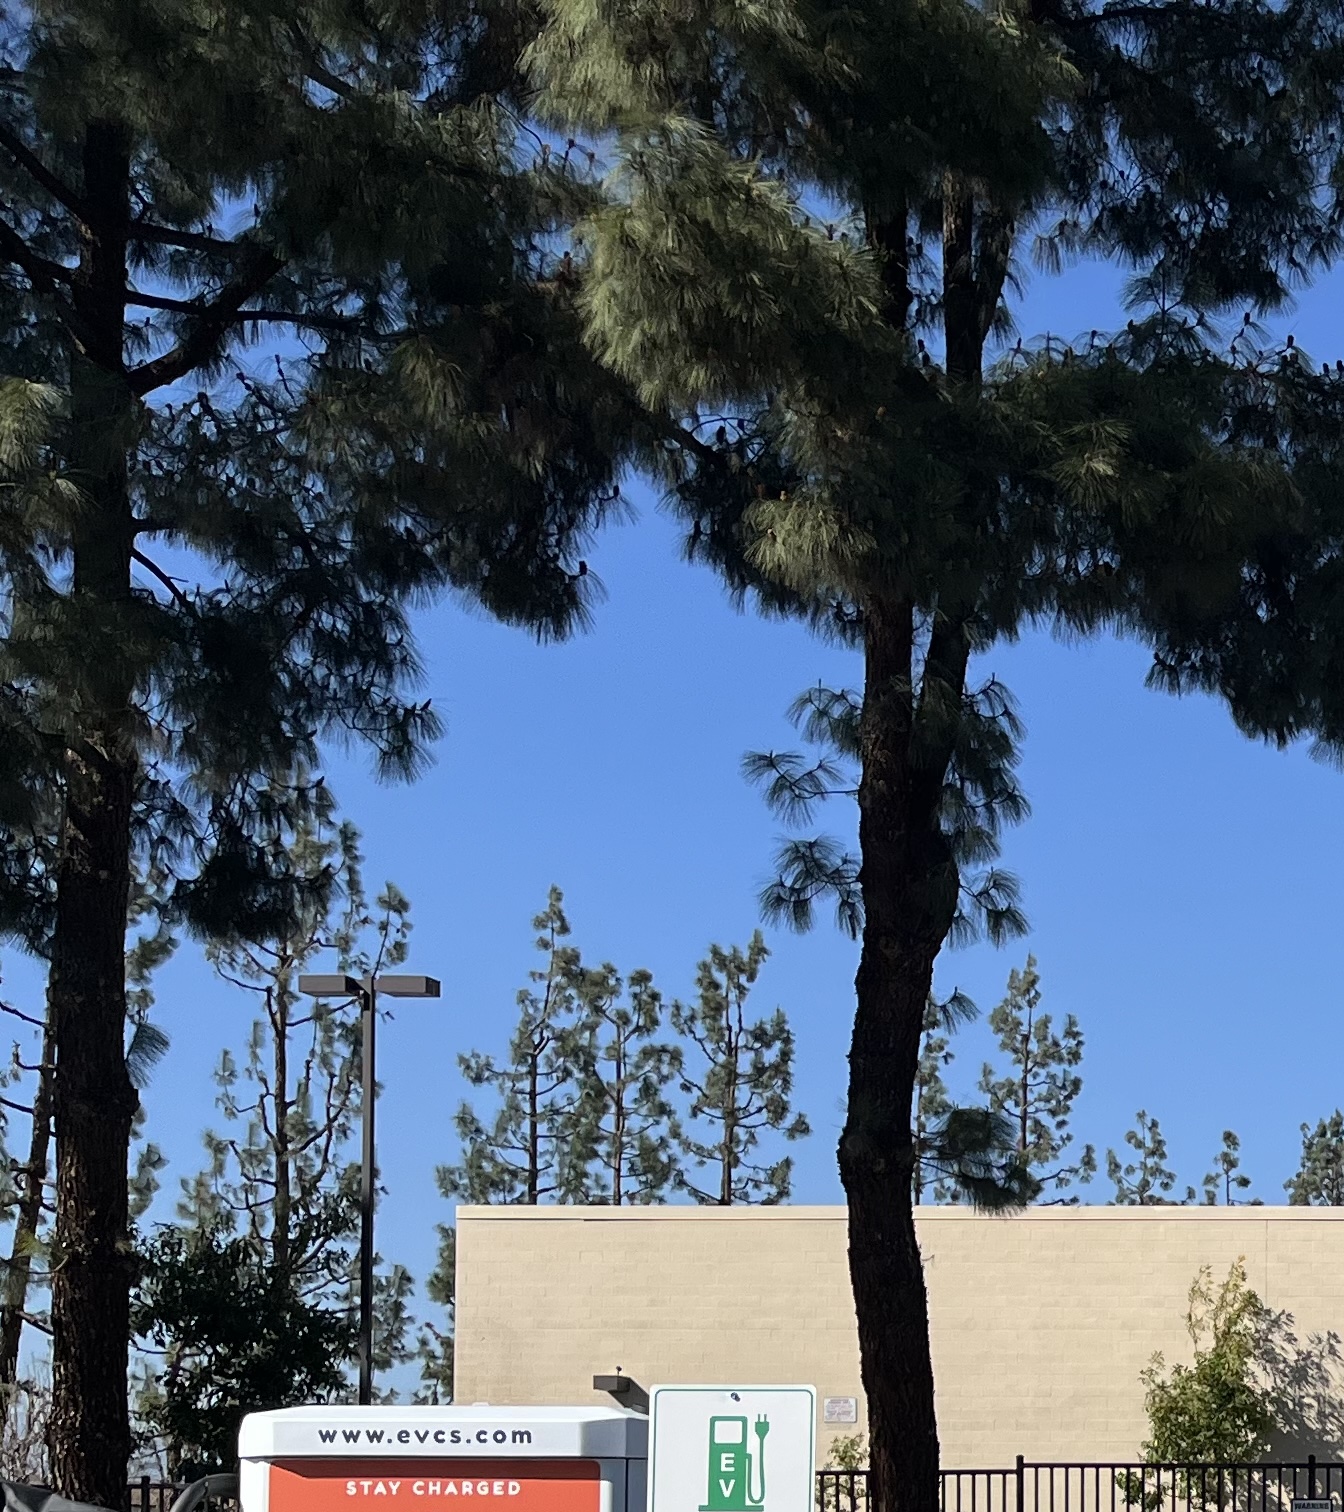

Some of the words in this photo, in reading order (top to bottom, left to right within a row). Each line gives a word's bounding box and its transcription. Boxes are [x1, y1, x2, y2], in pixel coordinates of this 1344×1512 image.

[318, 1429, 533, 1444] www.evcs.com
[346, 1481, 401, 1496] STAY
[412, 1481, 521, 1496] CHARGED
